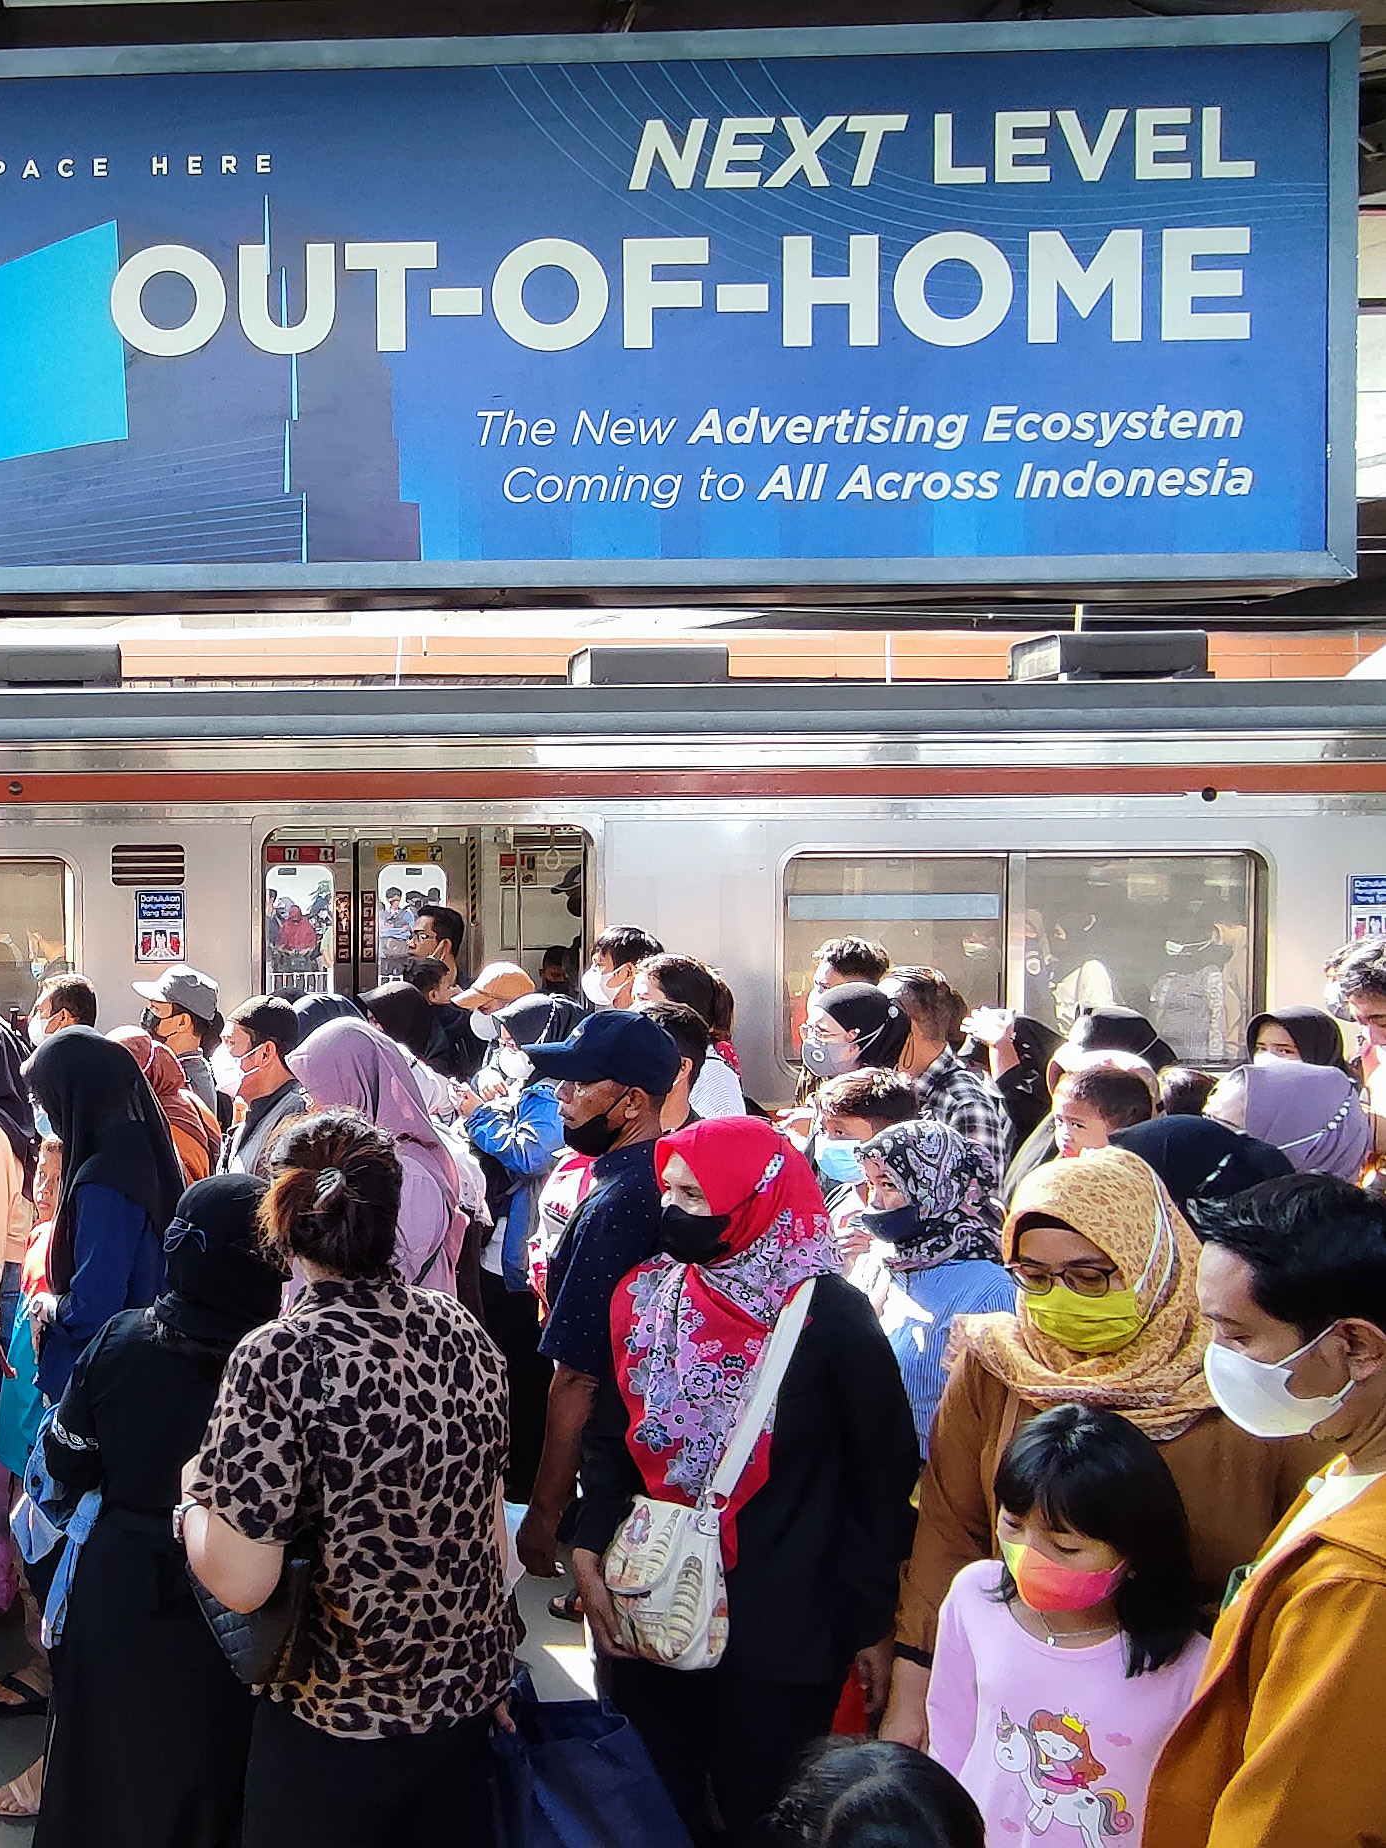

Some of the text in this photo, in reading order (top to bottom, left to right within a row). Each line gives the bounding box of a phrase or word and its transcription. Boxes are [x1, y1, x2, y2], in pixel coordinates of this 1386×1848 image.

[151, 154, 271, 175] HERE
[628, 106, 1256, 190] NEXT LEVEL
[111, 227, 1251, 356] OUT-OF-HOME
[476, 404, 1244, 450] The New Advertising Ecosystem
[503, 458, 1254, 509] Coming to All Across Indonesia
